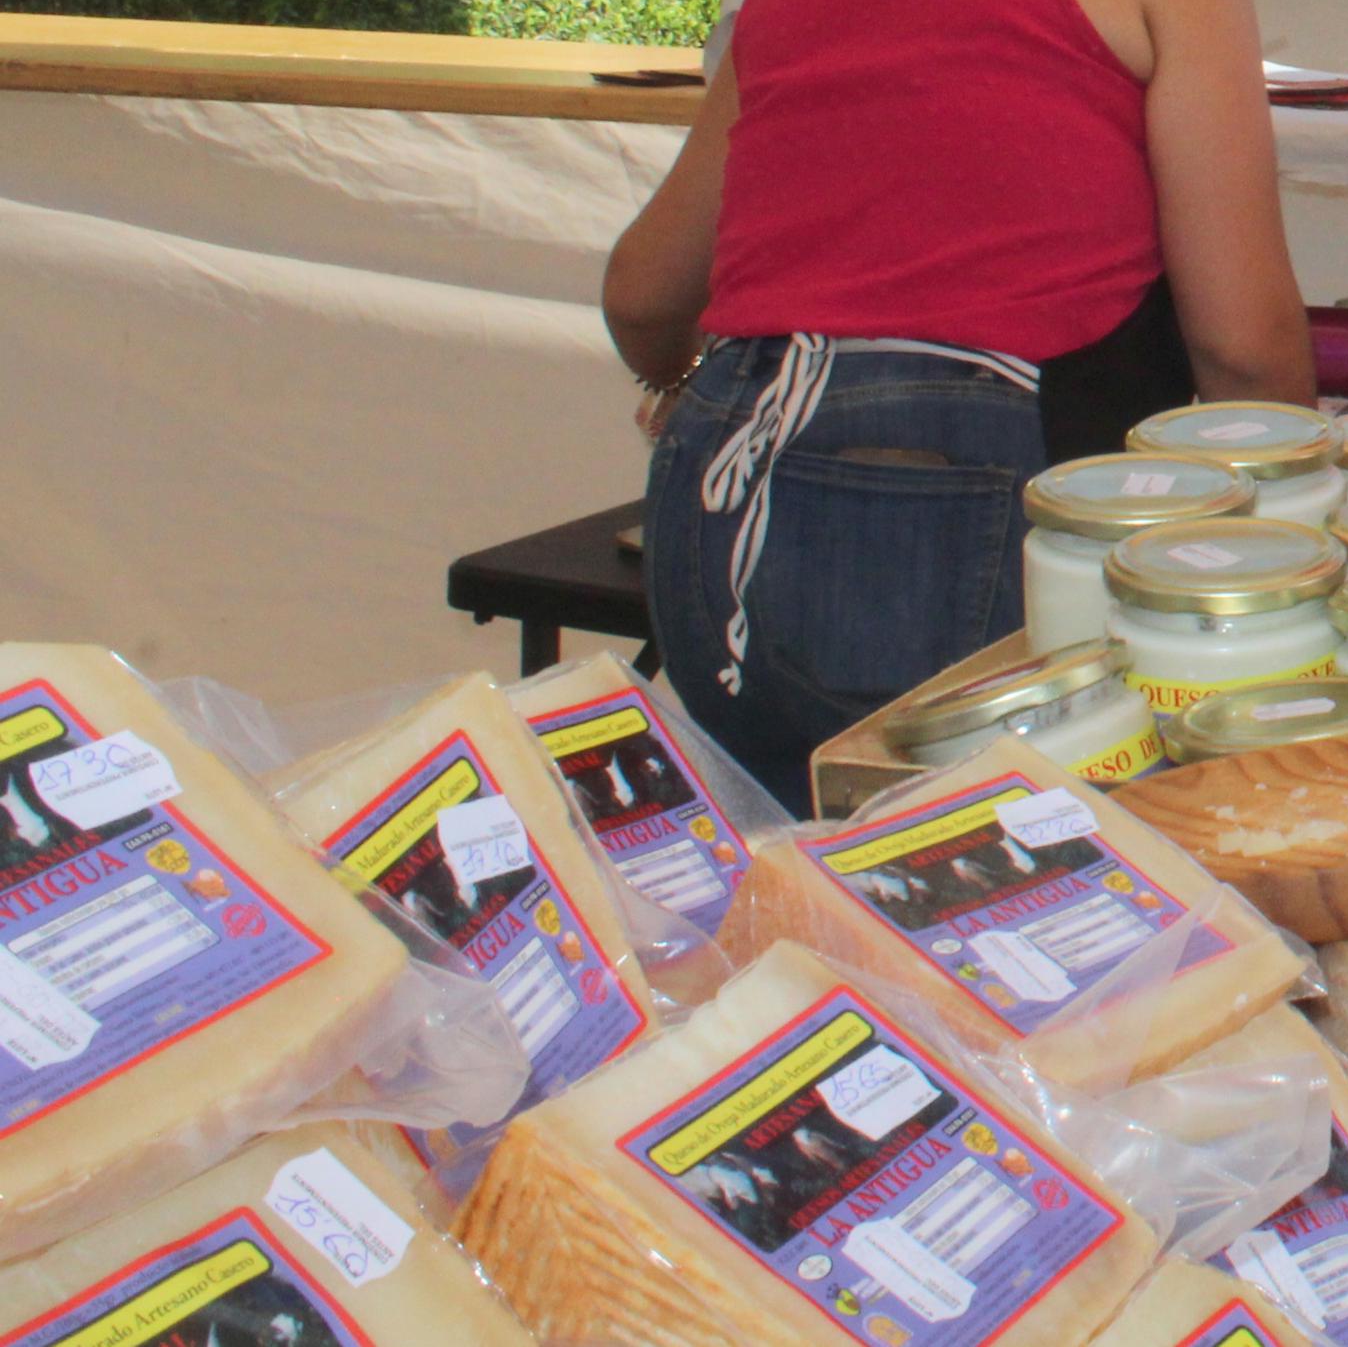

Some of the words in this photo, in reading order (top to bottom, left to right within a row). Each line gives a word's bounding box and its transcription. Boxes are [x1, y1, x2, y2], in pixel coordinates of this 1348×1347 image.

[600, 814, 679, 852] NTIGUA
[0, 849, 129, 930] NTIGUA
[946, 912, 989, 939] LA
[988, 875, 1094, 928] ANTIGUA
[808, 1208, 856, 1250] LA
[845, 1135, 953, 1222] ANTIGUA
[133, 1281, 208, 1333] Artesano
[205, 1255, 255, 1286] Casero
